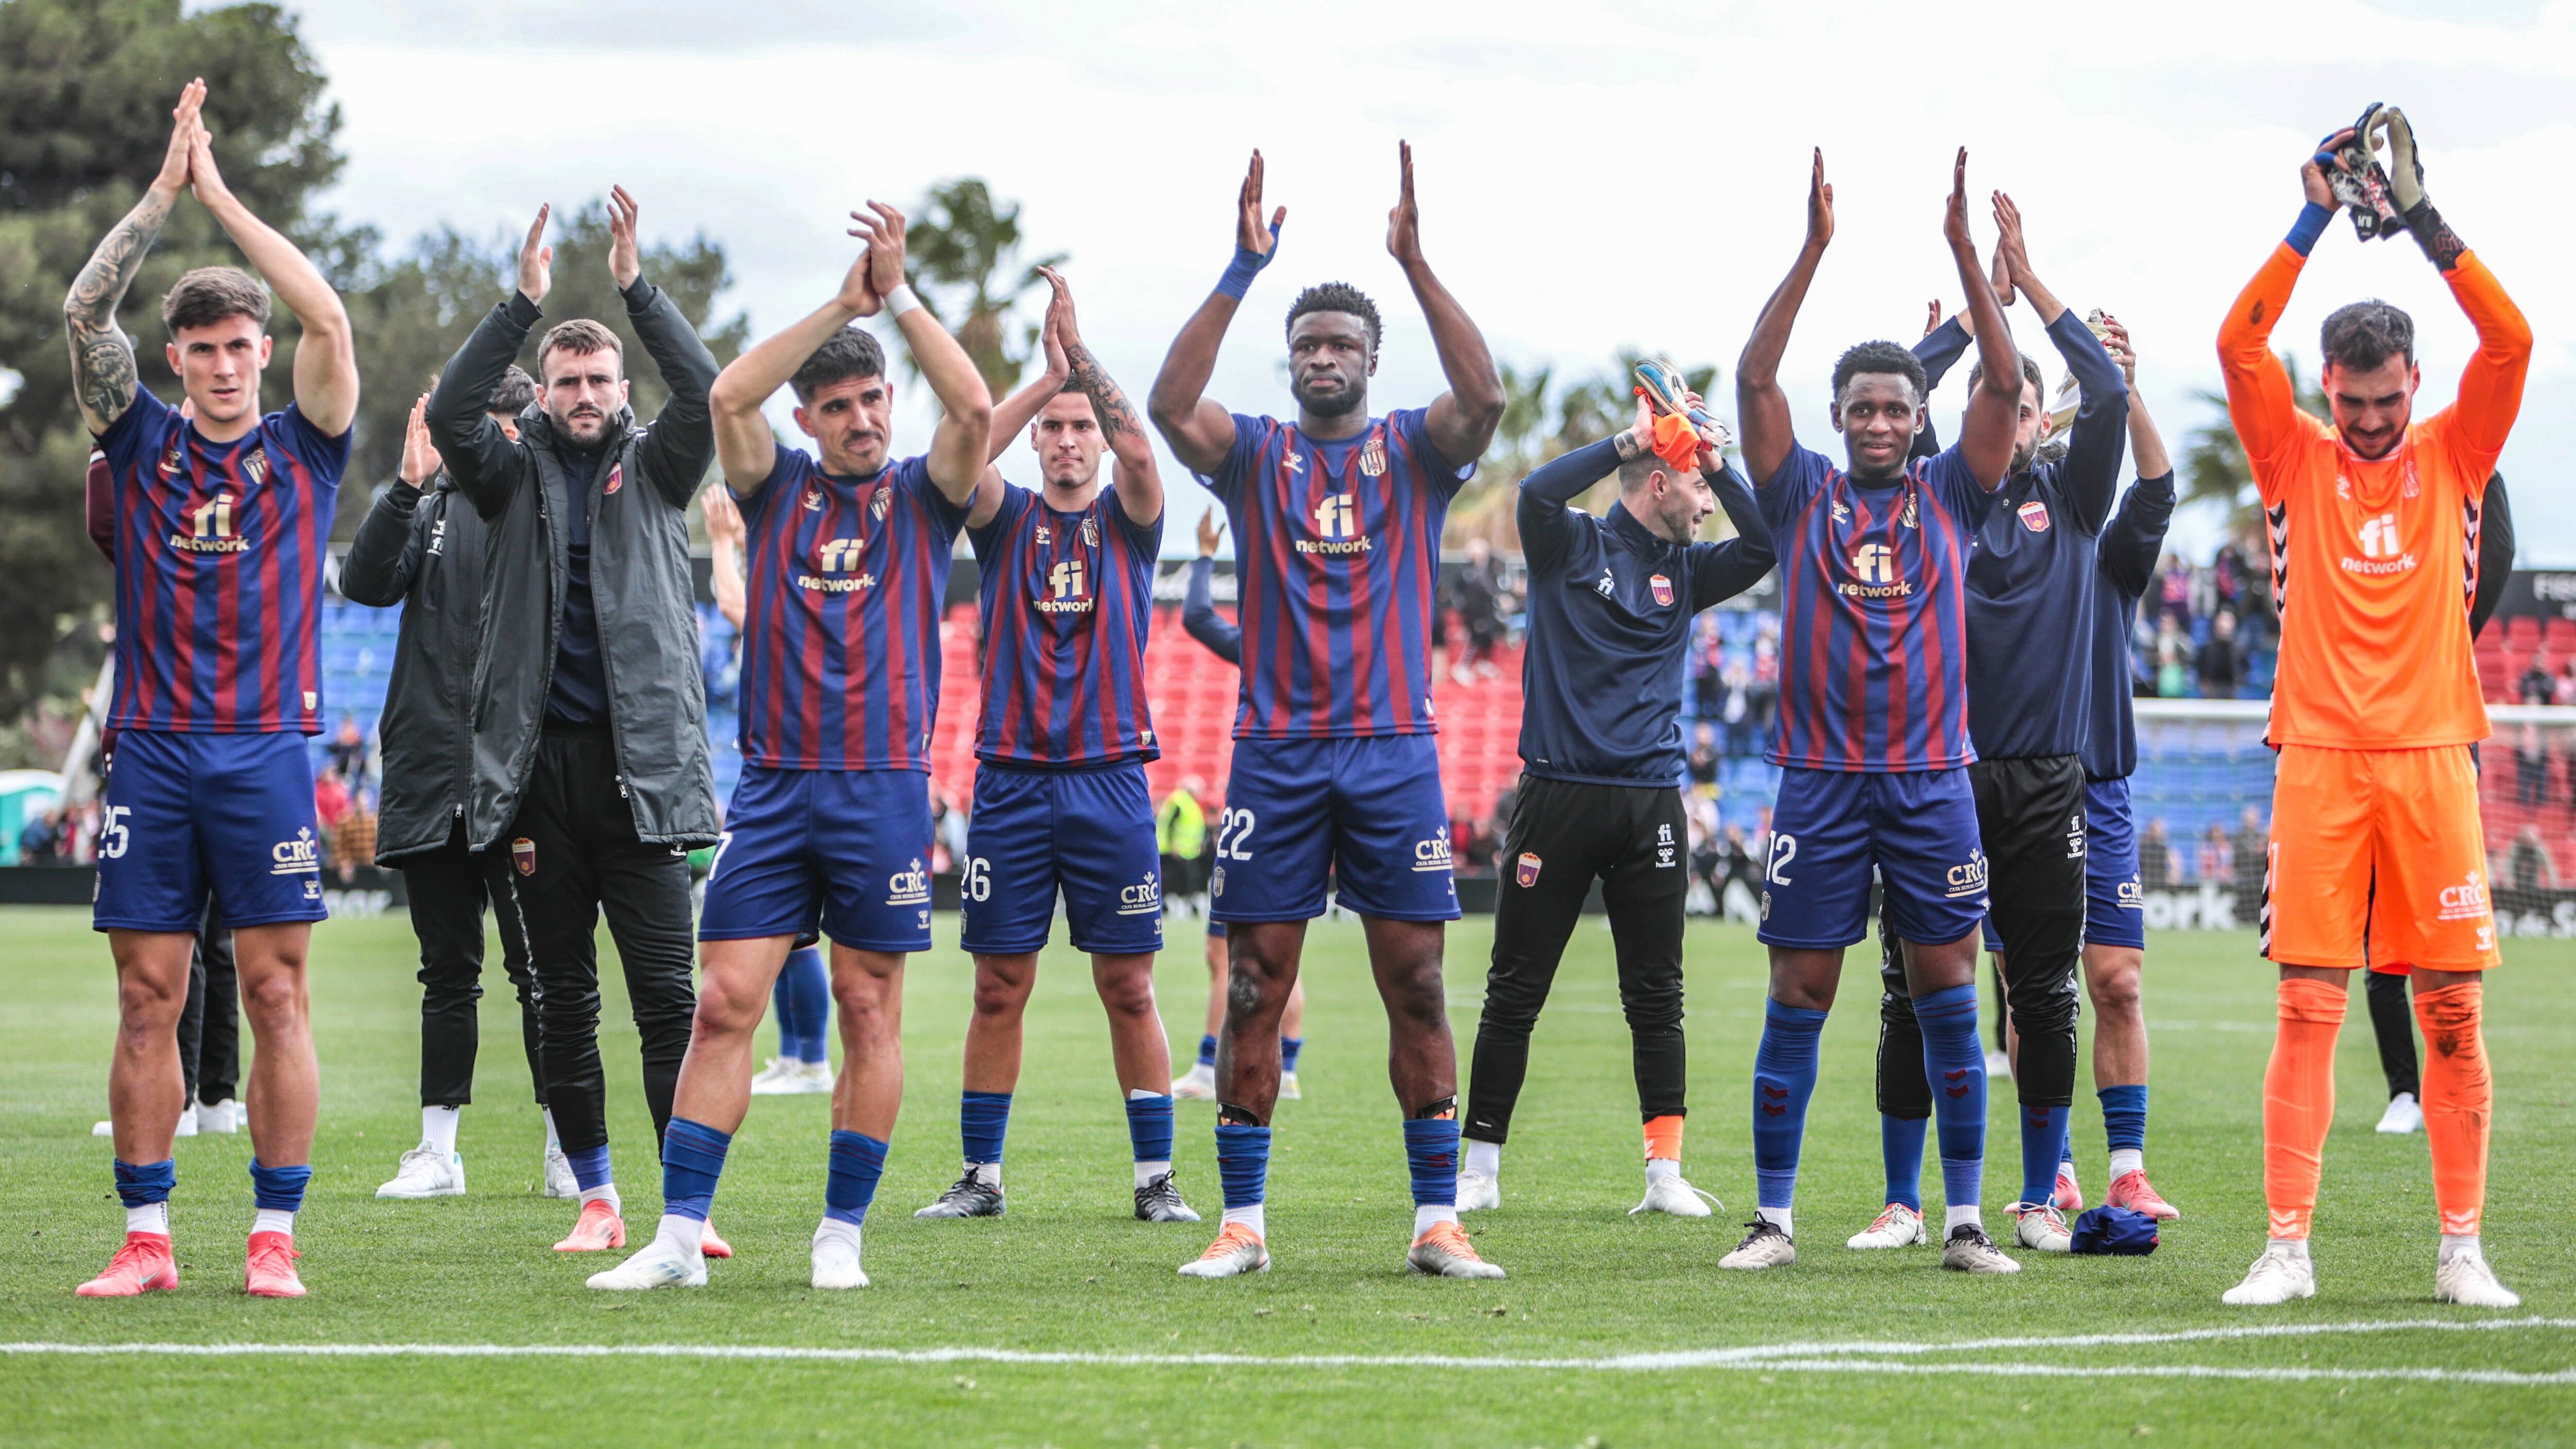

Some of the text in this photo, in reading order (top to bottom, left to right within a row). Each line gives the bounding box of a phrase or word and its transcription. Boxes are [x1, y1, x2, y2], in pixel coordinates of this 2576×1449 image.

[1315, 495, 1354, 537] fi
[170, 535, 250, 552] network
[1296, 536, 1372, 554] network
[2359, 514, 2399, 556] fi
[820, 539, 863, 572] fi
[1853, 544, 1893, 583] fi
[2341, 553, 2416, 574] network
[798, 573, 875, 592] network
[1049, 560, 1082, 599] fi
[1837, 581, 1912, 598] network
[1217, 807, 1255, 861] 22
[1657, 824, 1672, 842] fi
[273, 840, 317, 863] CRC
[1415, 839, 1451, 860] CRC
[1766, 830, 1797, 886] 12
[889, 871, 927, 894] CRC
[961, 854, 991, 901] 26
[1947, 859, 1984, 885] CRC
[1121, 882, 1158, 904] CRC
[2439, 883, 2485, 907] CRC
